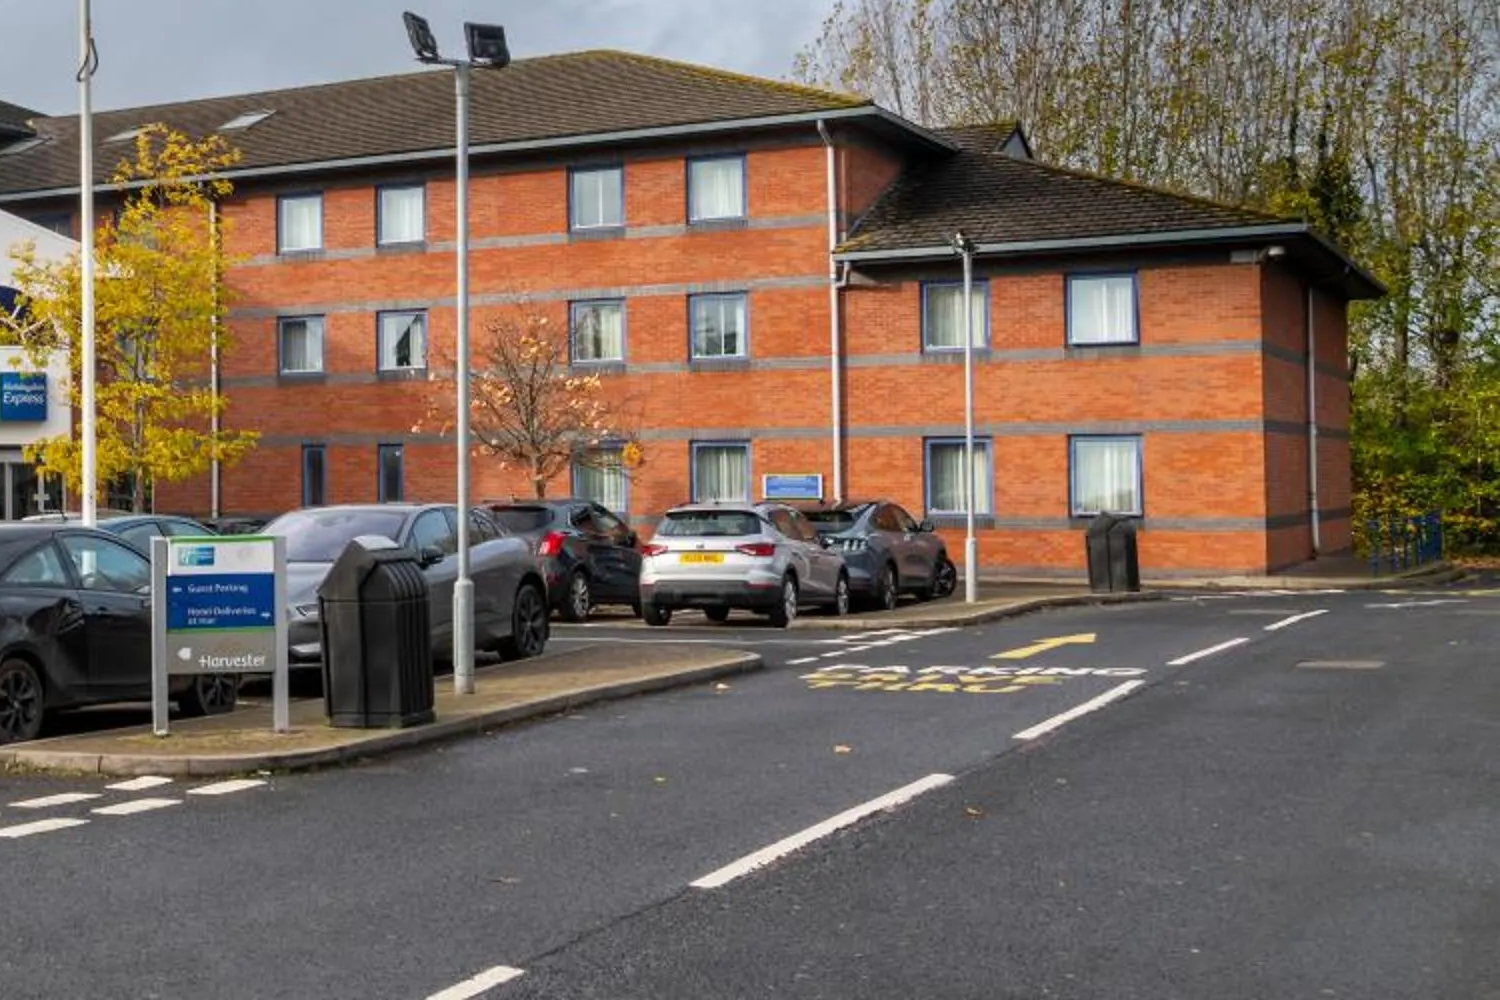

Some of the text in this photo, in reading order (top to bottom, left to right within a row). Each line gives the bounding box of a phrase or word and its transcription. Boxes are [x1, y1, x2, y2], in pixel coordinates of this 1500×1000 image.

[3, 391, 44, 406] Express
[199, 654, 265, 667] Harvester
[816, 663, 1149, 676] PARKING
